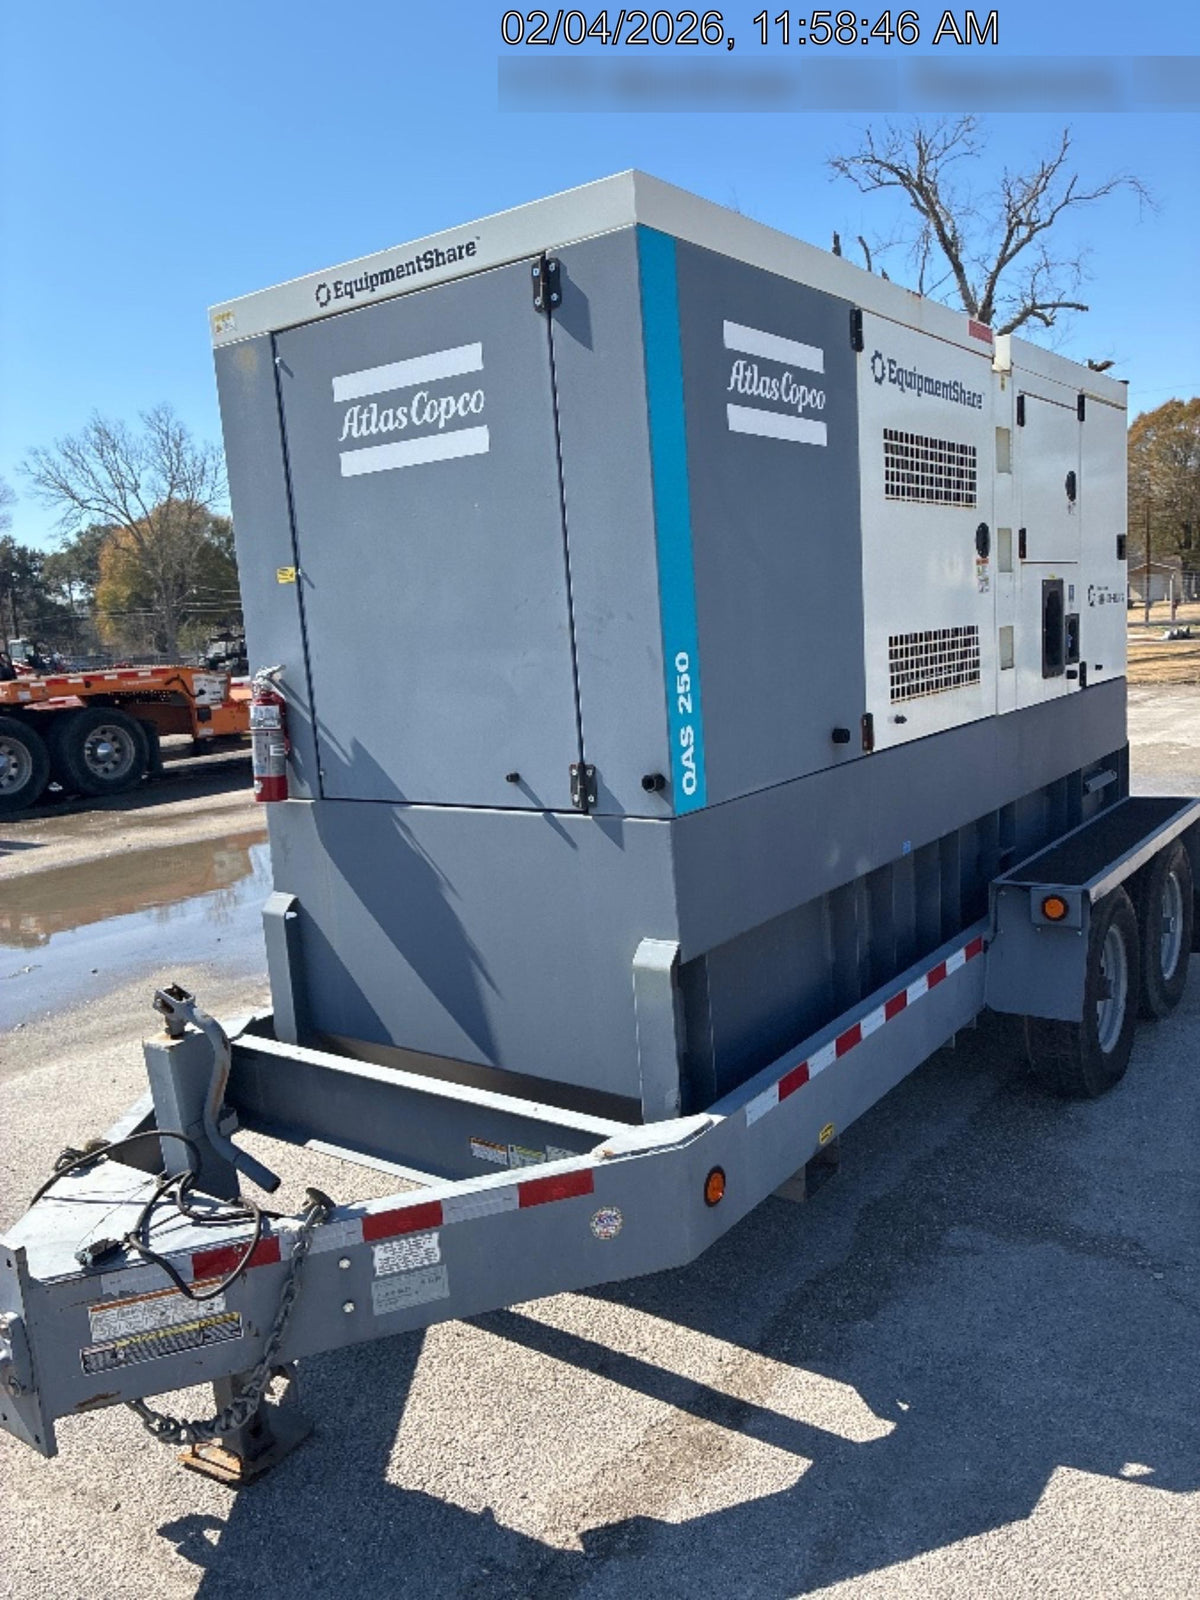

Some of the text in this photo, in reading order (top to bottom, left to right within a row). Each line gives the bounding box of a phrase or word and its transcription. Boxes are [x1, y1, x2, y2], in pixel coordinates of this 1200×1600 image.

[333, 240, 477, 299] EquipmentShare
[887, 357, 983, 409] EquipmentShare
[675, 651, 693, 715] 250
